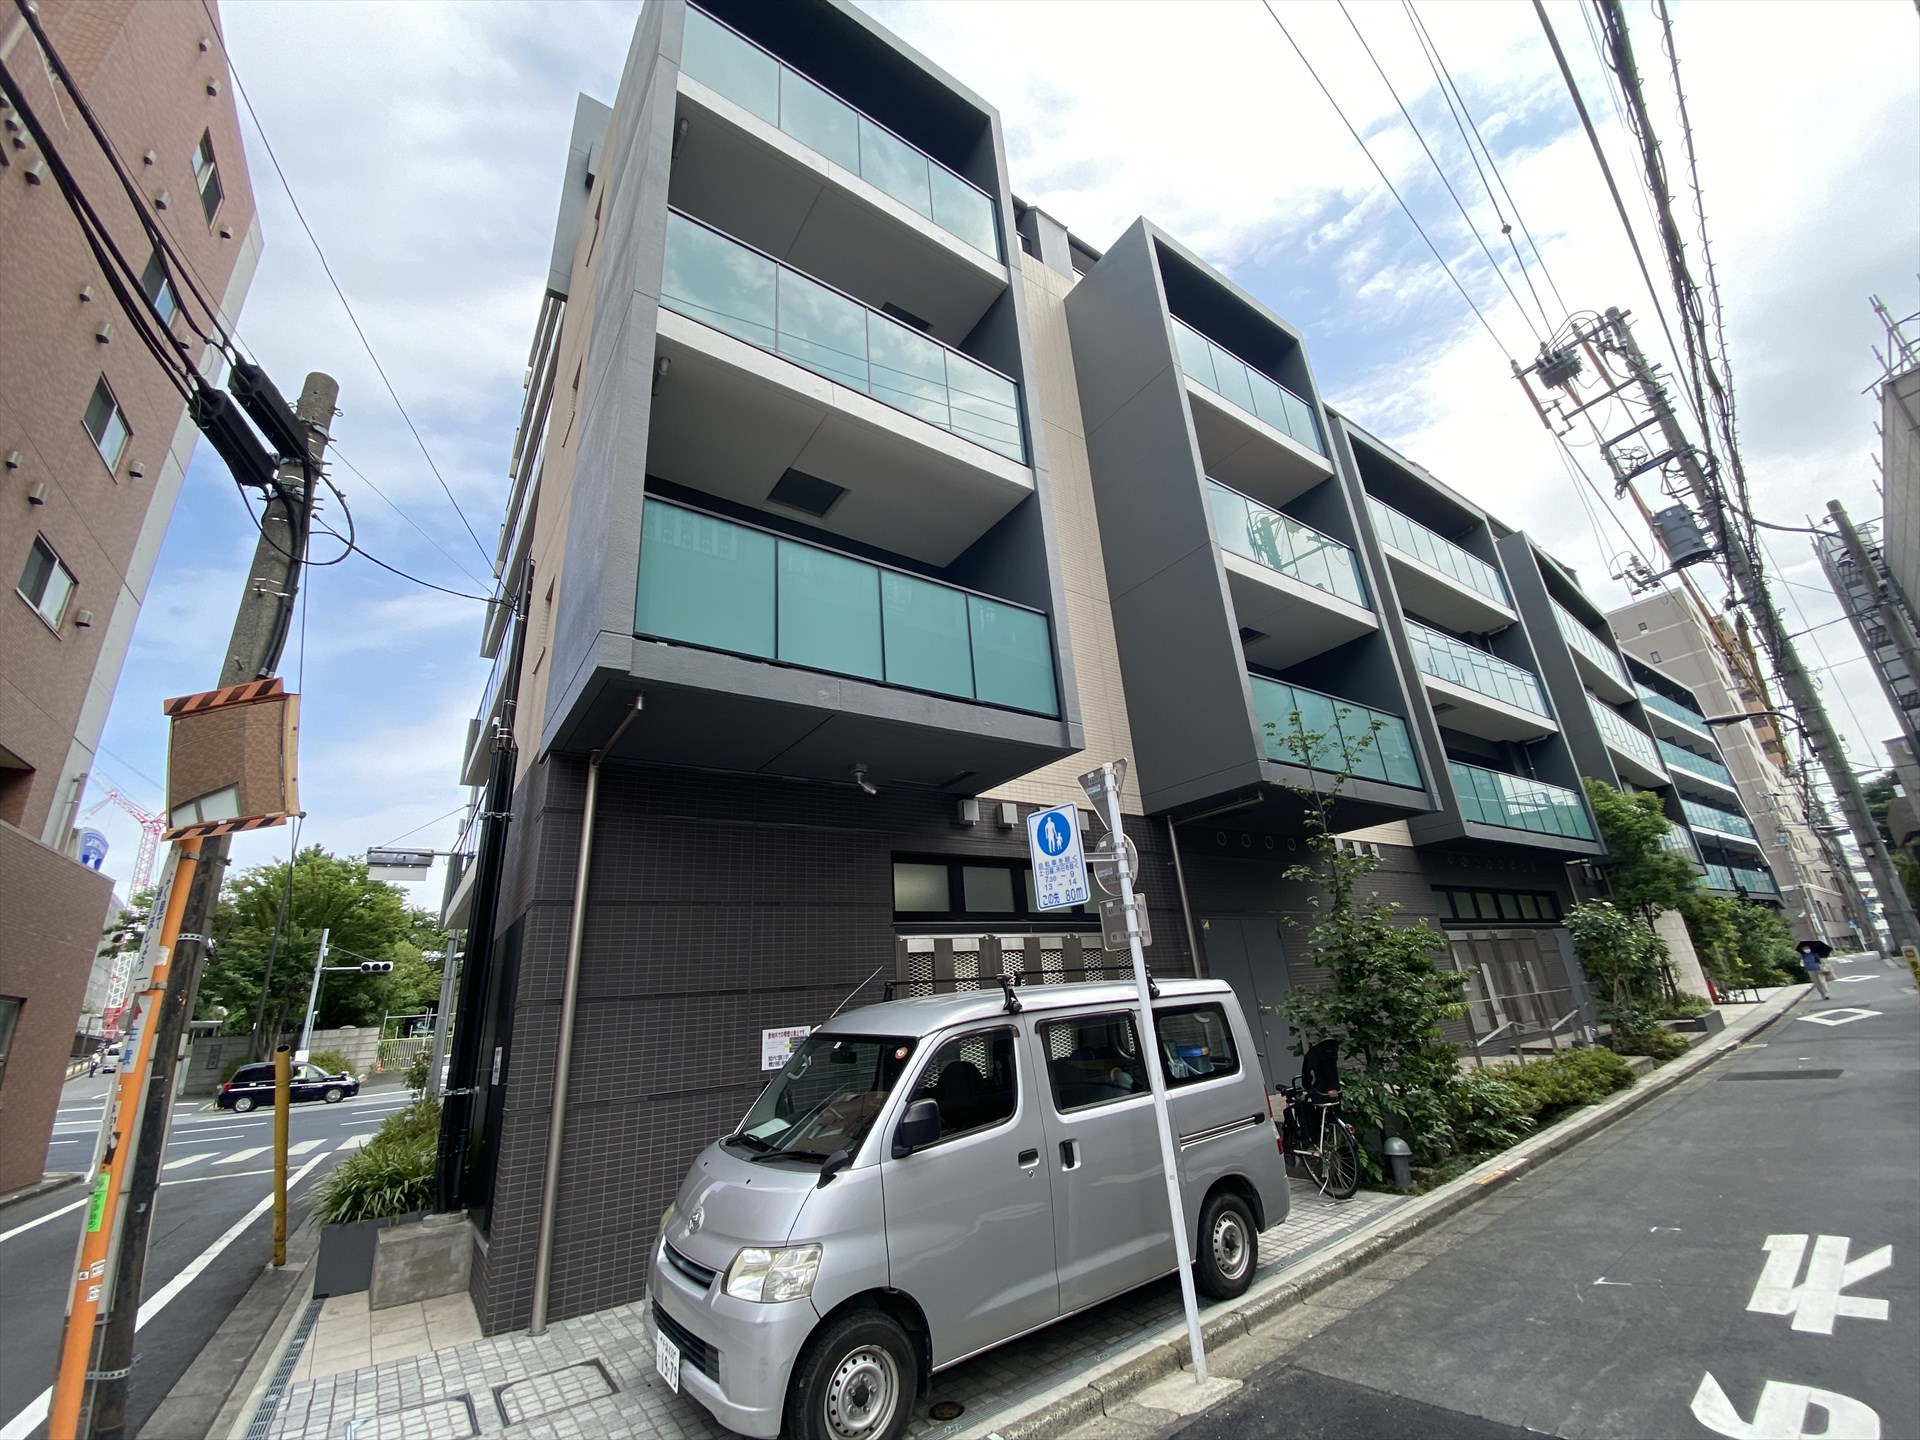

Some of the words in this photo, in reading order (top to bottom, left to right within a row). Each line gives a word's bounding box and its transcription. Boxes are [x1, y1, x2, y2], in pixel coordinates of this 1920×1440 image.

[1043, 892, 1060, 905] この先
[1065, 887, 1083, 901] 80m
